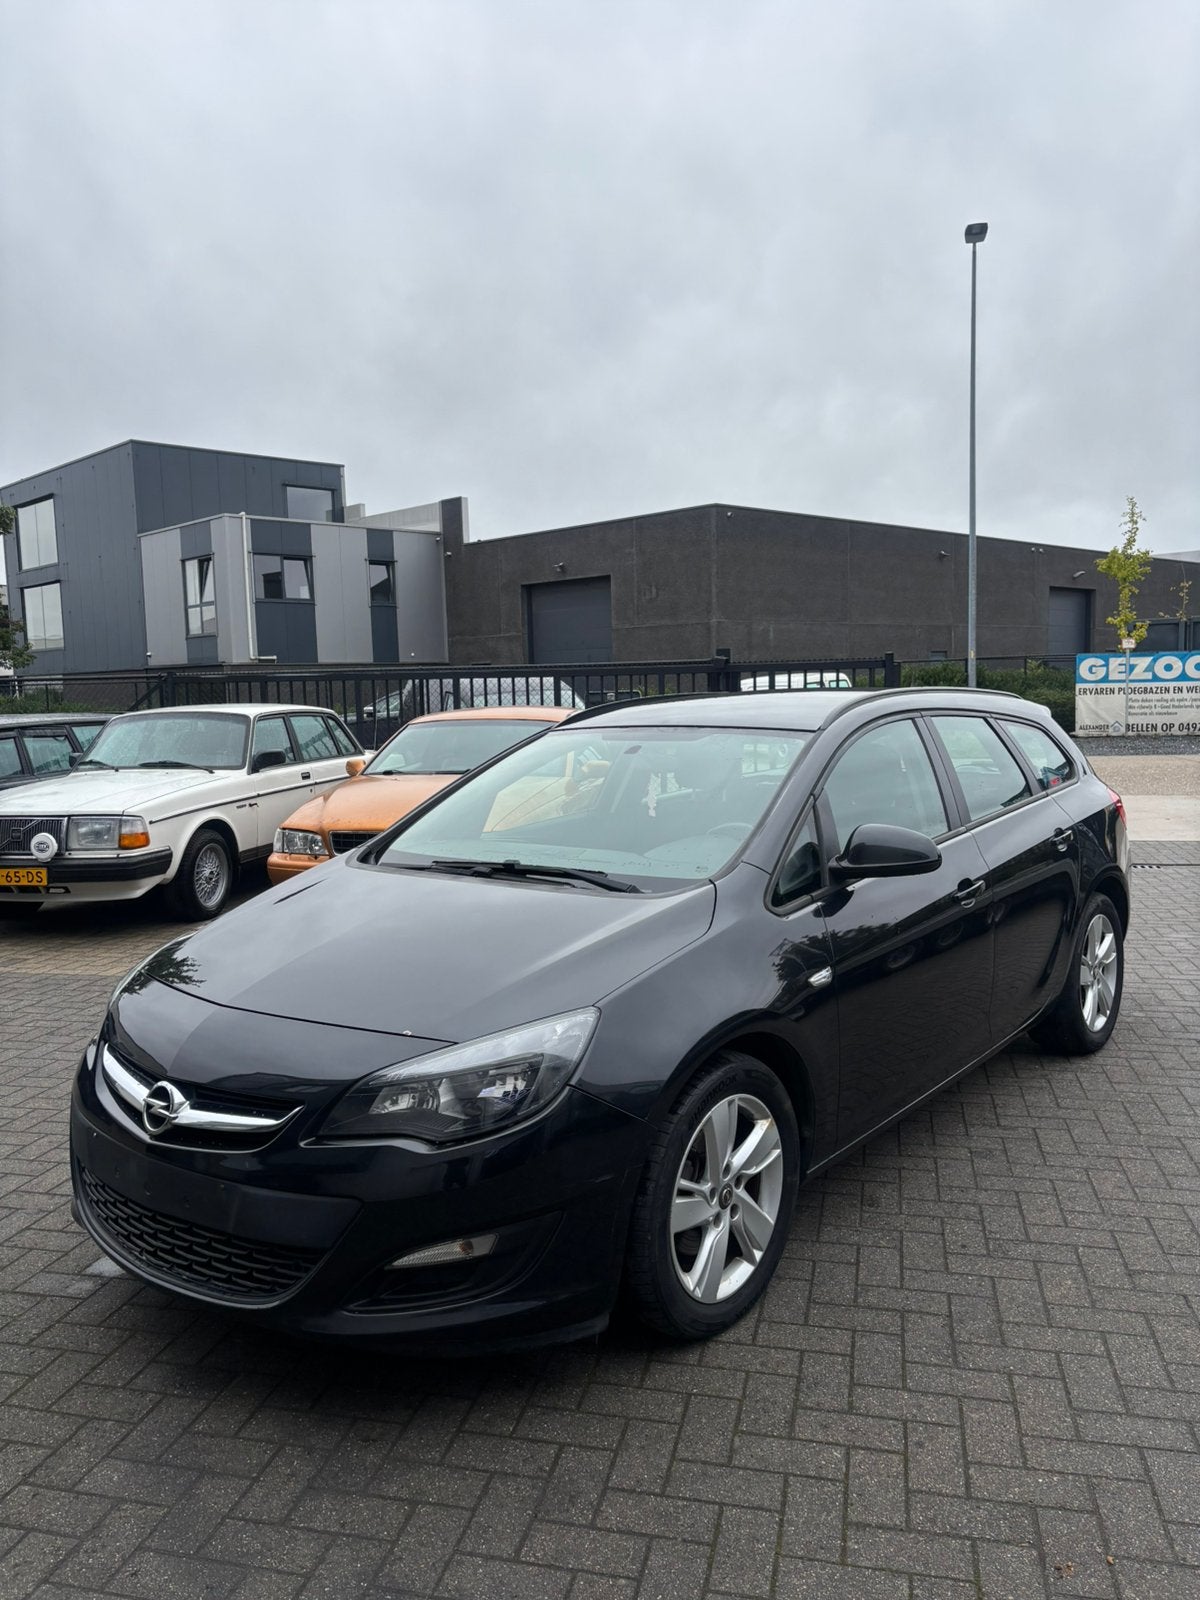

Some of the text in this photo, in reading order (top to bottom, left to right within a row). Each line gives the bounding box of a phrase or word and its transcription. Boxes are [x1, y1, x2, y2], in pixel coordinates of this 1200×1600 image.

[1078, 685, 1200, 696] ERVAREN PLOEGBAZEN EN WE
[1125, 723, 1157, 732] BELLEN
[1161, 723, 1175, 732] OP
